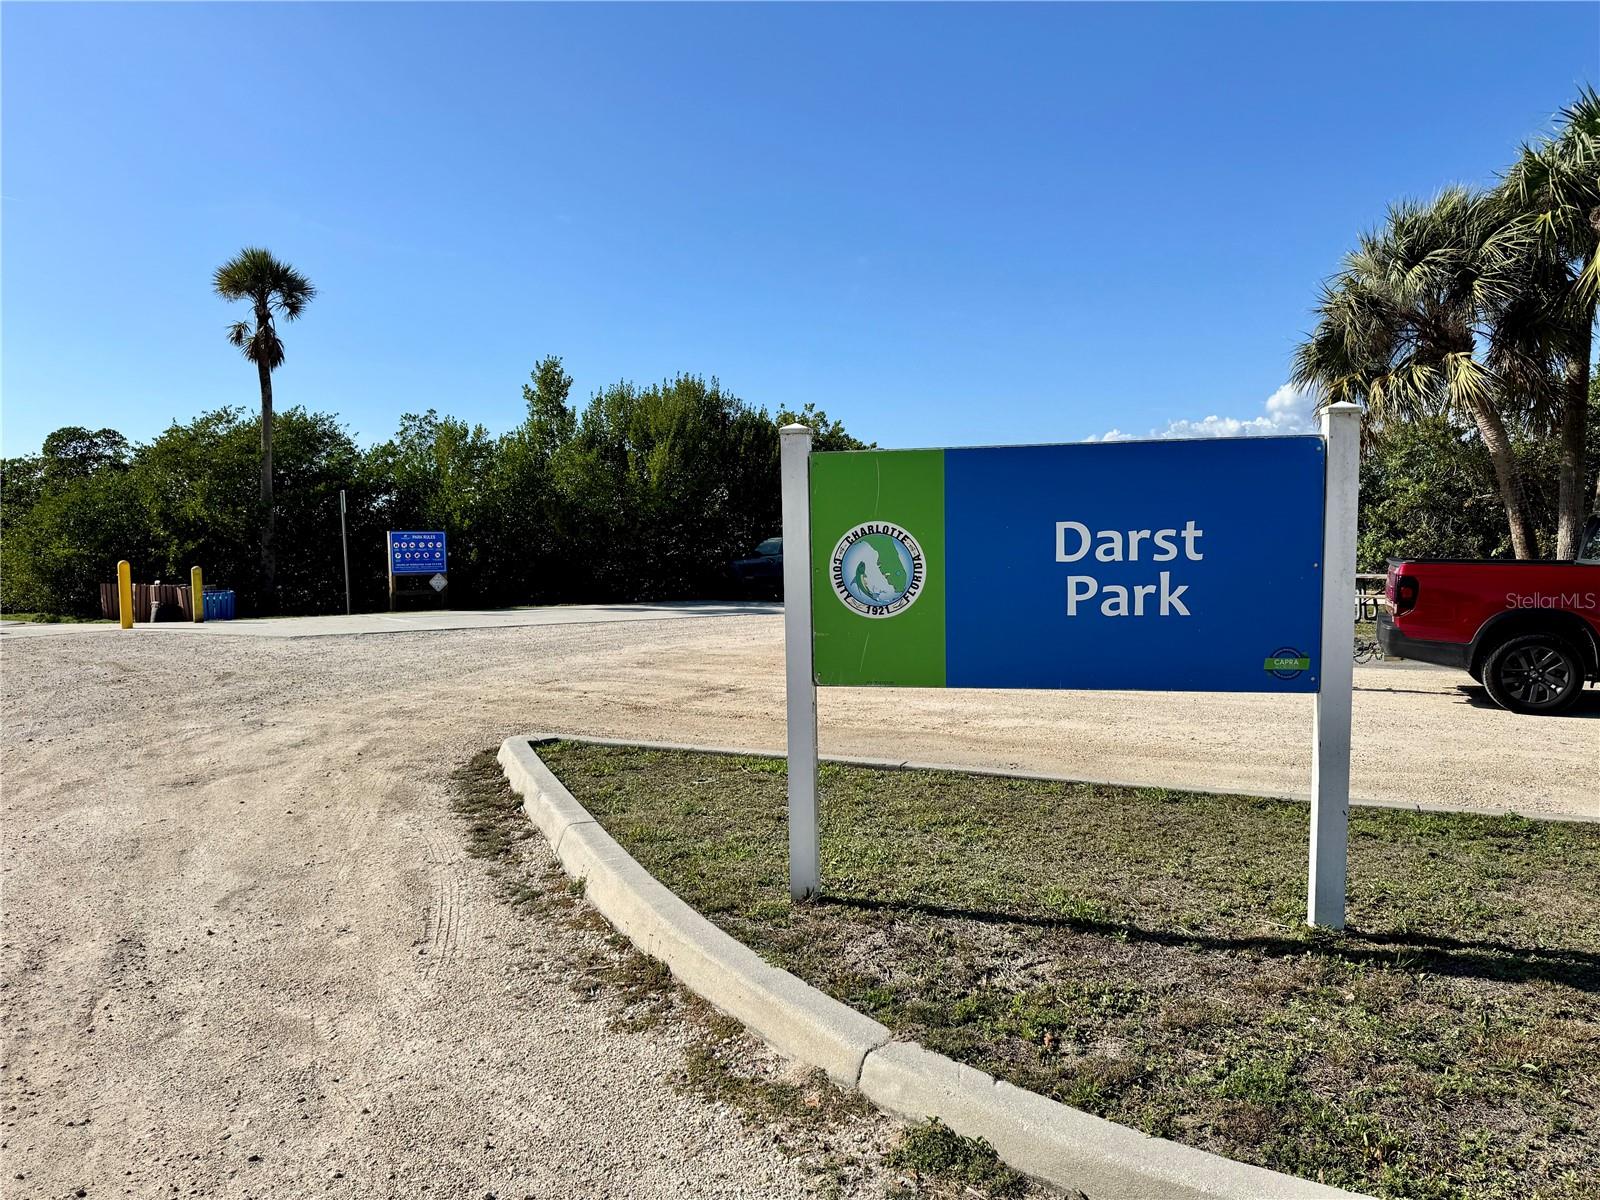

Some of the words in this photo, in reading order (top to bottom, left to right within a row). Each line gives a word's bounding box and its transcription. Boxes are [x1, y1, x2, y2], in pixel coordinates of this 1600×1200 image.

[845, 524, 910, 545] CHARLOTTE
[1055, 520, 1204, 562] Darst
[833, 558, 853, 601] COUNTY
[903, 554, 923, 602] FLORIDA
[1066, 571, 1191, 617] Park
[866, 605, 890, 616] 1921
